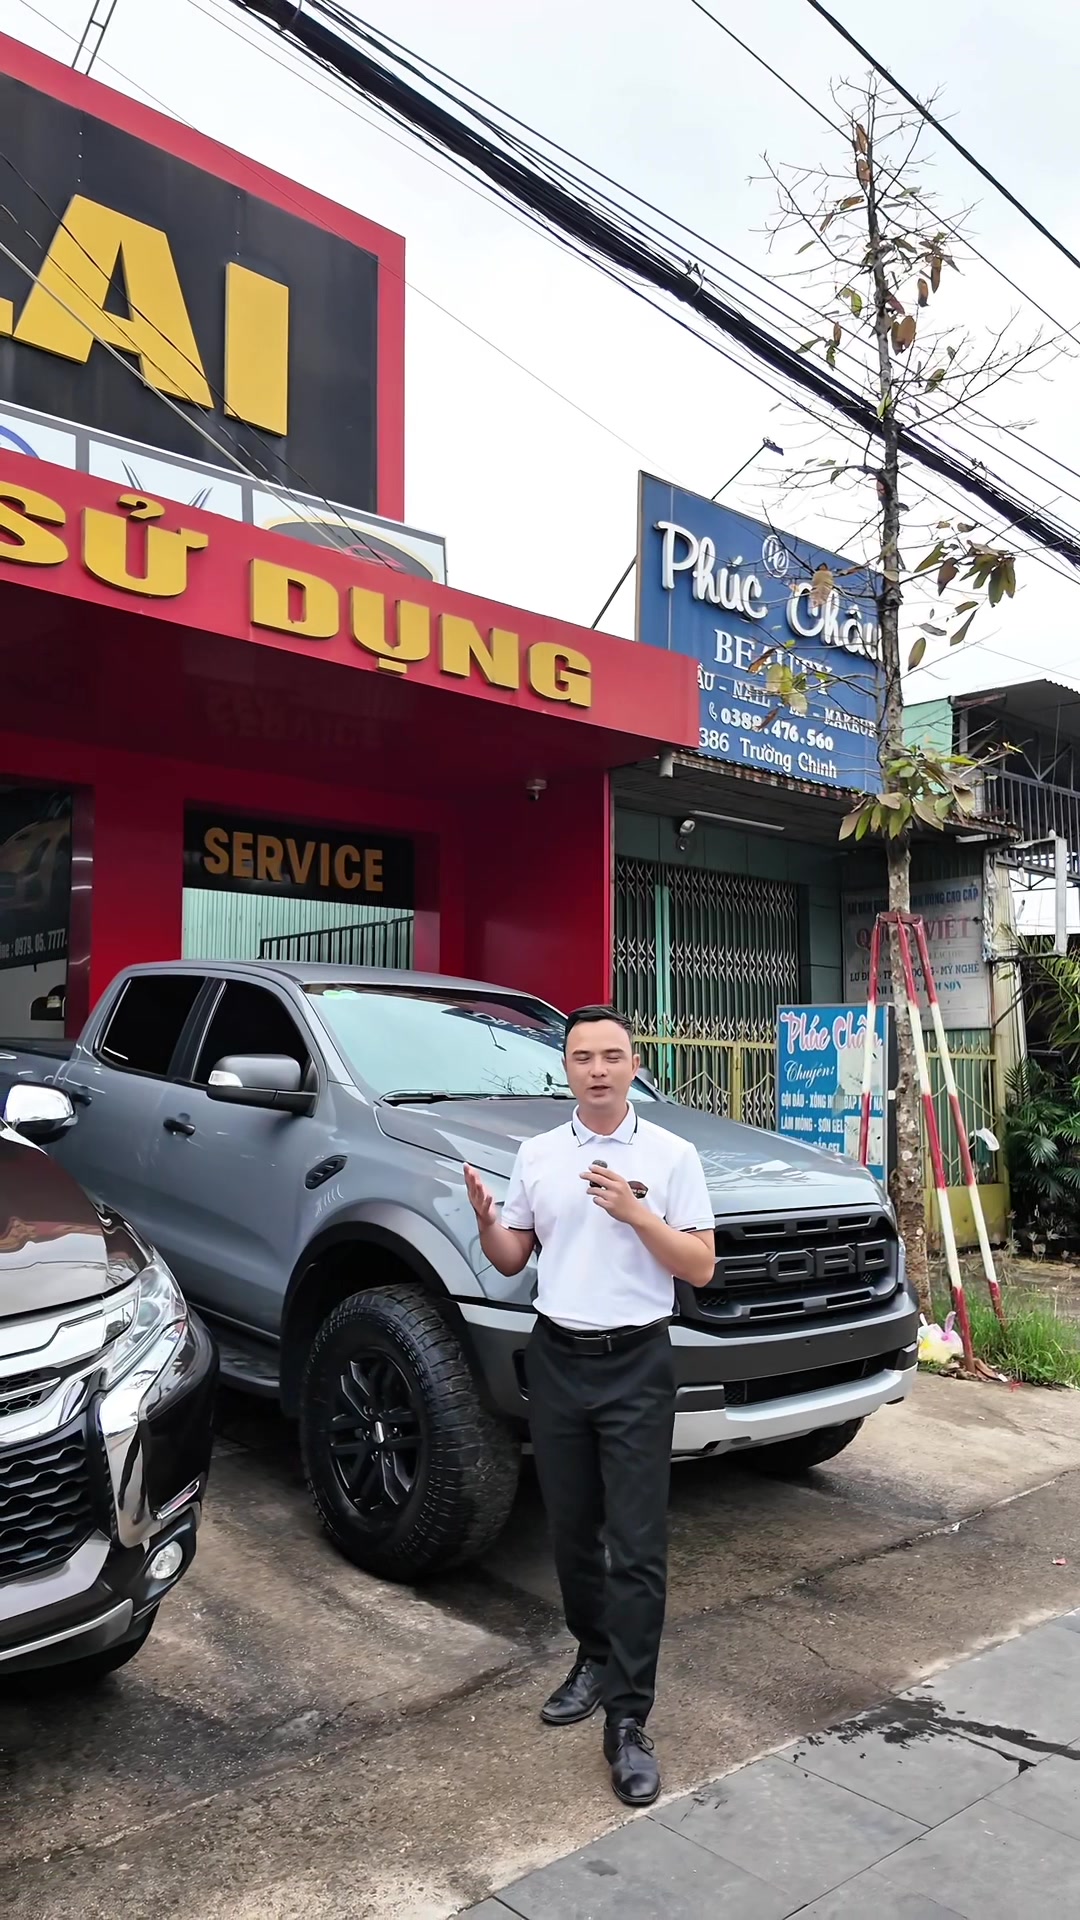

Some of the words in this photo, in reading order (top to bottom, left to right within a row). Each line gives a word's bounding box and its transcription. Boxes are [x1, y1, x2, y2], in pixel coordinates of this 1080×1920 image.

[0, 194, 290, 437] AI
[653, 520, 768, 620] Phúc
[249, 557, 592, 708] DỤNG
[786, 582, 884, 662] Châu
[698, 727, 730, 752] 386
[739, 737, 792, 773] Trường
[798, 752, 837, 779] Chinh
[720, 708, 834, 751] 0388.476.560
[204, 827, 384, 893] SERVICE
